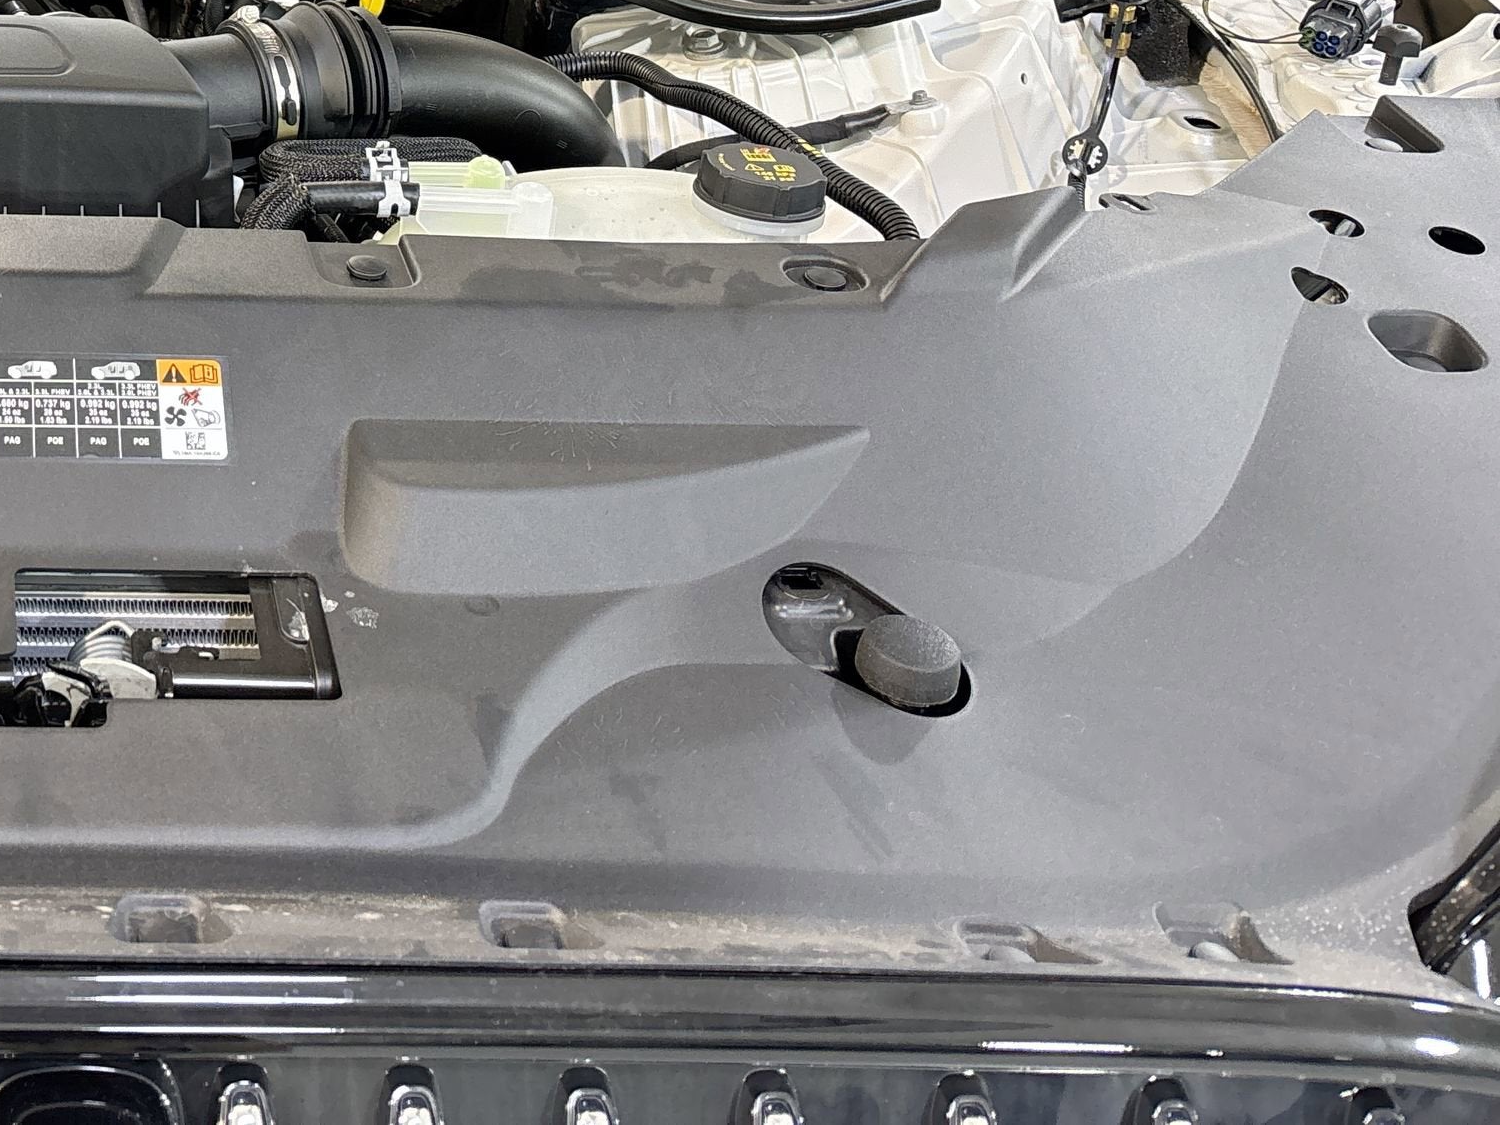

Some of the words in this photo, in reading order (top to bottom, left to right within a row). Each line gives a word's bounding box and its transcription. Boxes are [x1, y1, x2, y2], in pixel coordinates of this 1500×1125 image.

[18, 399, 29, 410] kg
[35, 399, 58, 408] 0.737
[59, 399, 71, 410] kg
[80, 399, 103, 408] 0.992
[104, 399, 116, 410] kg
[122, 400, 145, 409] 0.992
[146, 400, 157, 411] kg
[89, 408, 98, 416] 35
[131, 409, 140, 417] 35
[14, 416, 26, 424] lbs
[56, 416, 68, 424] lbs
[101, 416, 113, 424] lbs
[143, 417, 155, 425] lbs
[4, 436, 21, 445] PAG
[47, 436, 64, 445] POE
[90, 437, 107, 445] PAG
[133, 437, 150, 446] POE
